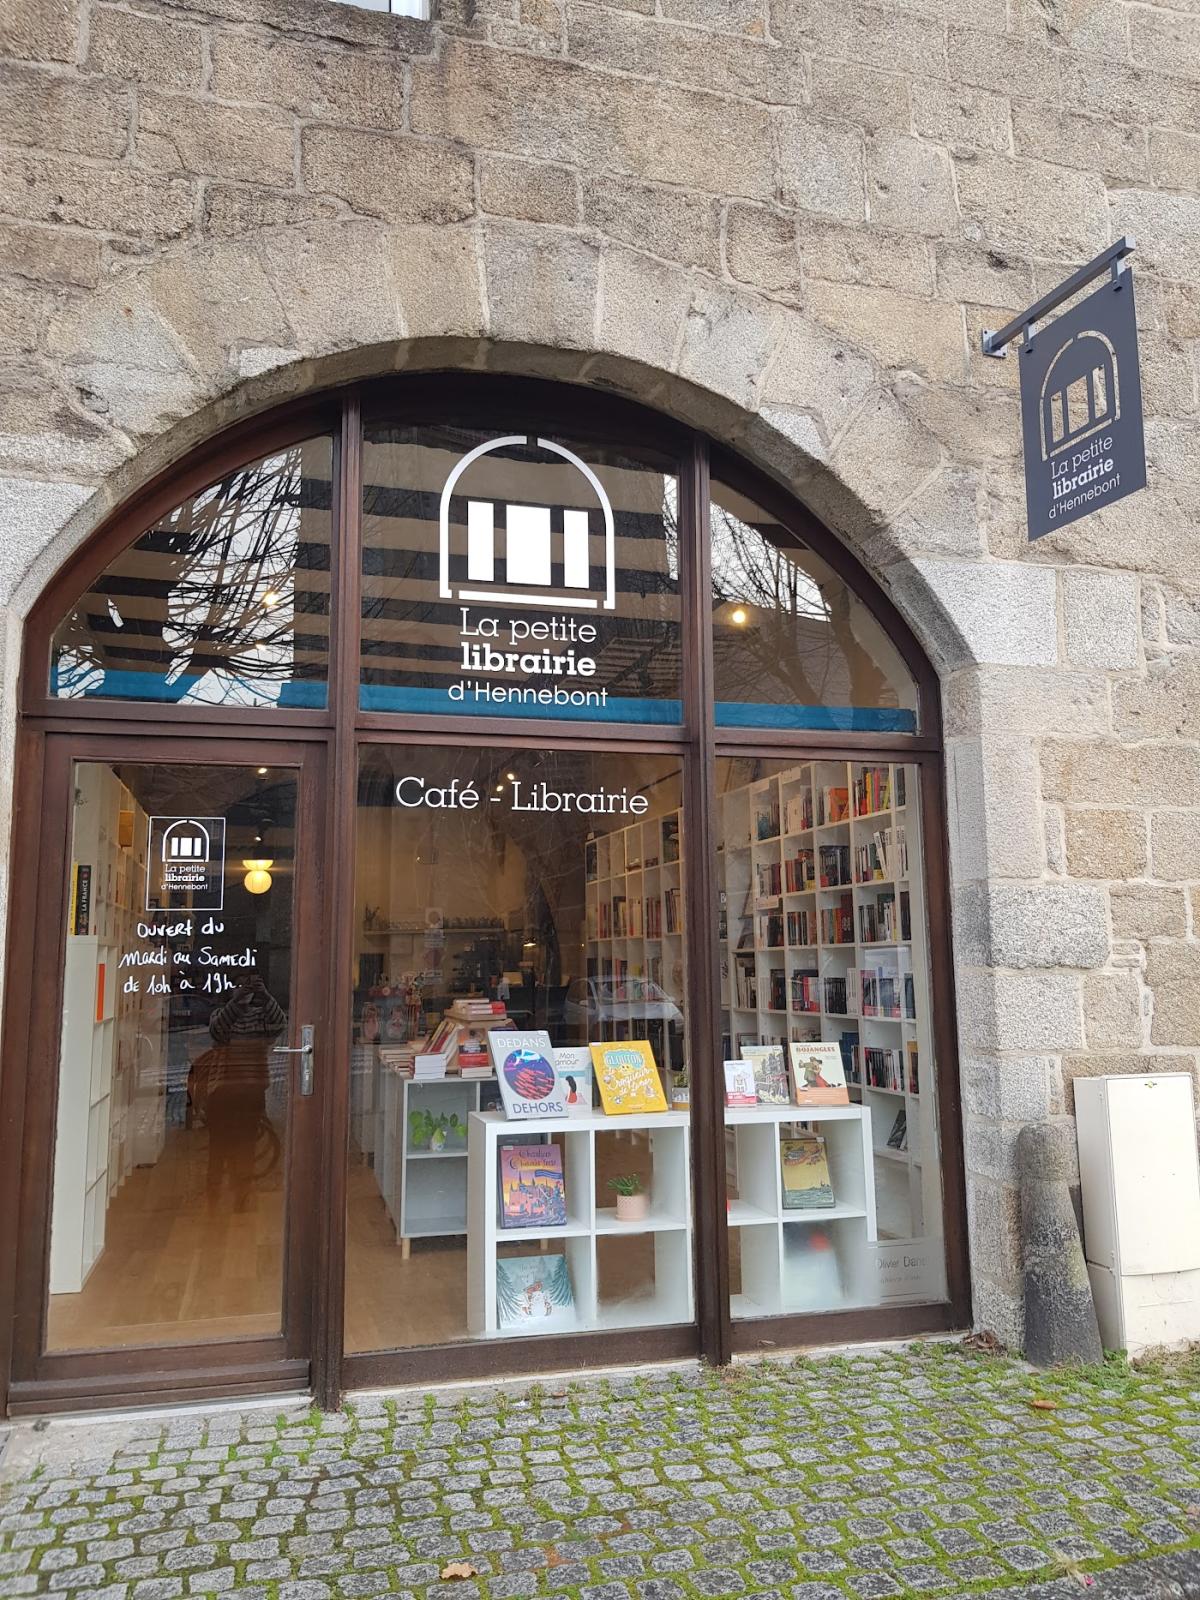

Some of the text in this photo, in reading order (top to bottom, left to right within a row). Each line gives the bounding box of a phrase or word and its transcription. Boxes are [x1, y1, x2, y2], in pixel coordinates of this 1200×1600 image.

[1051, 436, 1113, 480] La petite
[1052, 458, 1114, 500] librairie
[1048, 472, 1121, 519] d'Hennebont
[459, 607, 598, 646] La petite
[460, 641, 597, 677] librairie
[447, 680, 609, 707] d'Hennebont
[395, 776, 480, 810] Café
[510, 780, 650, 815] Librairie
[164, 873, 206, 882] librairie
[165, 864, 206, 875] La petite
[81, 880, 89, 912] LA FRANCE
[201, 917, 225, 935] du
[173, 951, 192, 965] au
[123, 975, 140, 994] de
[146, 974, 172, 996] 10h
[179, 970, 196, 990] à
[497, 1037, 547, 1049] DEDANS
[559, 1051, 575, 1060] Mon
[512, 1101, 564, 1114] DEHORS
